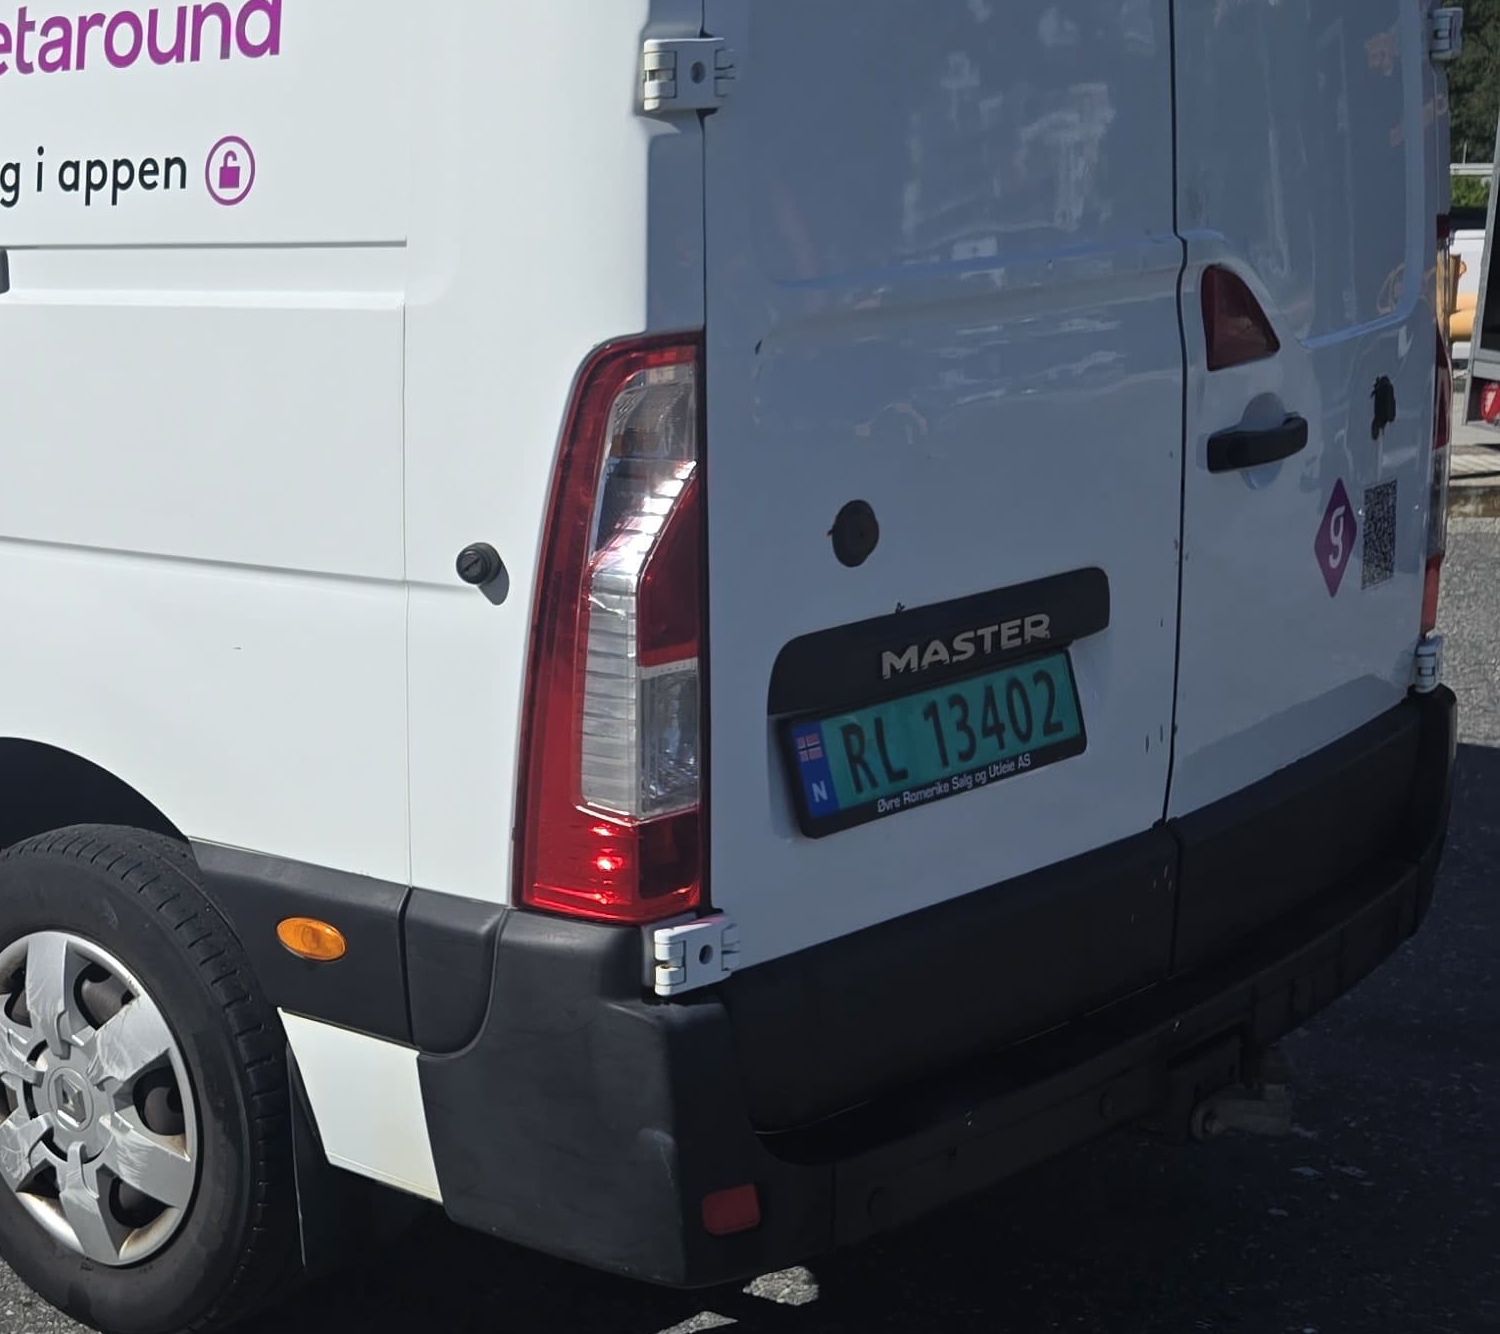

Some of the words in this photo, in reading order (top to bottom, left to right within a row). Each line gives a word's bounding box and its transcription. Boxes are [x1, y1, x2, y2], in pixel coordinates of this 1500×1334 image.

[35, 145, 45, 193] i
[58, 156, 187, 207] appen
[1328, 505, 1346, 568] g
[881, 613, 1051, 680] MASTER
[839, 717, 909, 795] RL
[922, 669, 1064, 770] 13402
[812, 780, 828, 803] N
[951, 773, 973, 790] Salg
[974, 770, 987, 785] og
[1017, 753, 1031, 769] AS
